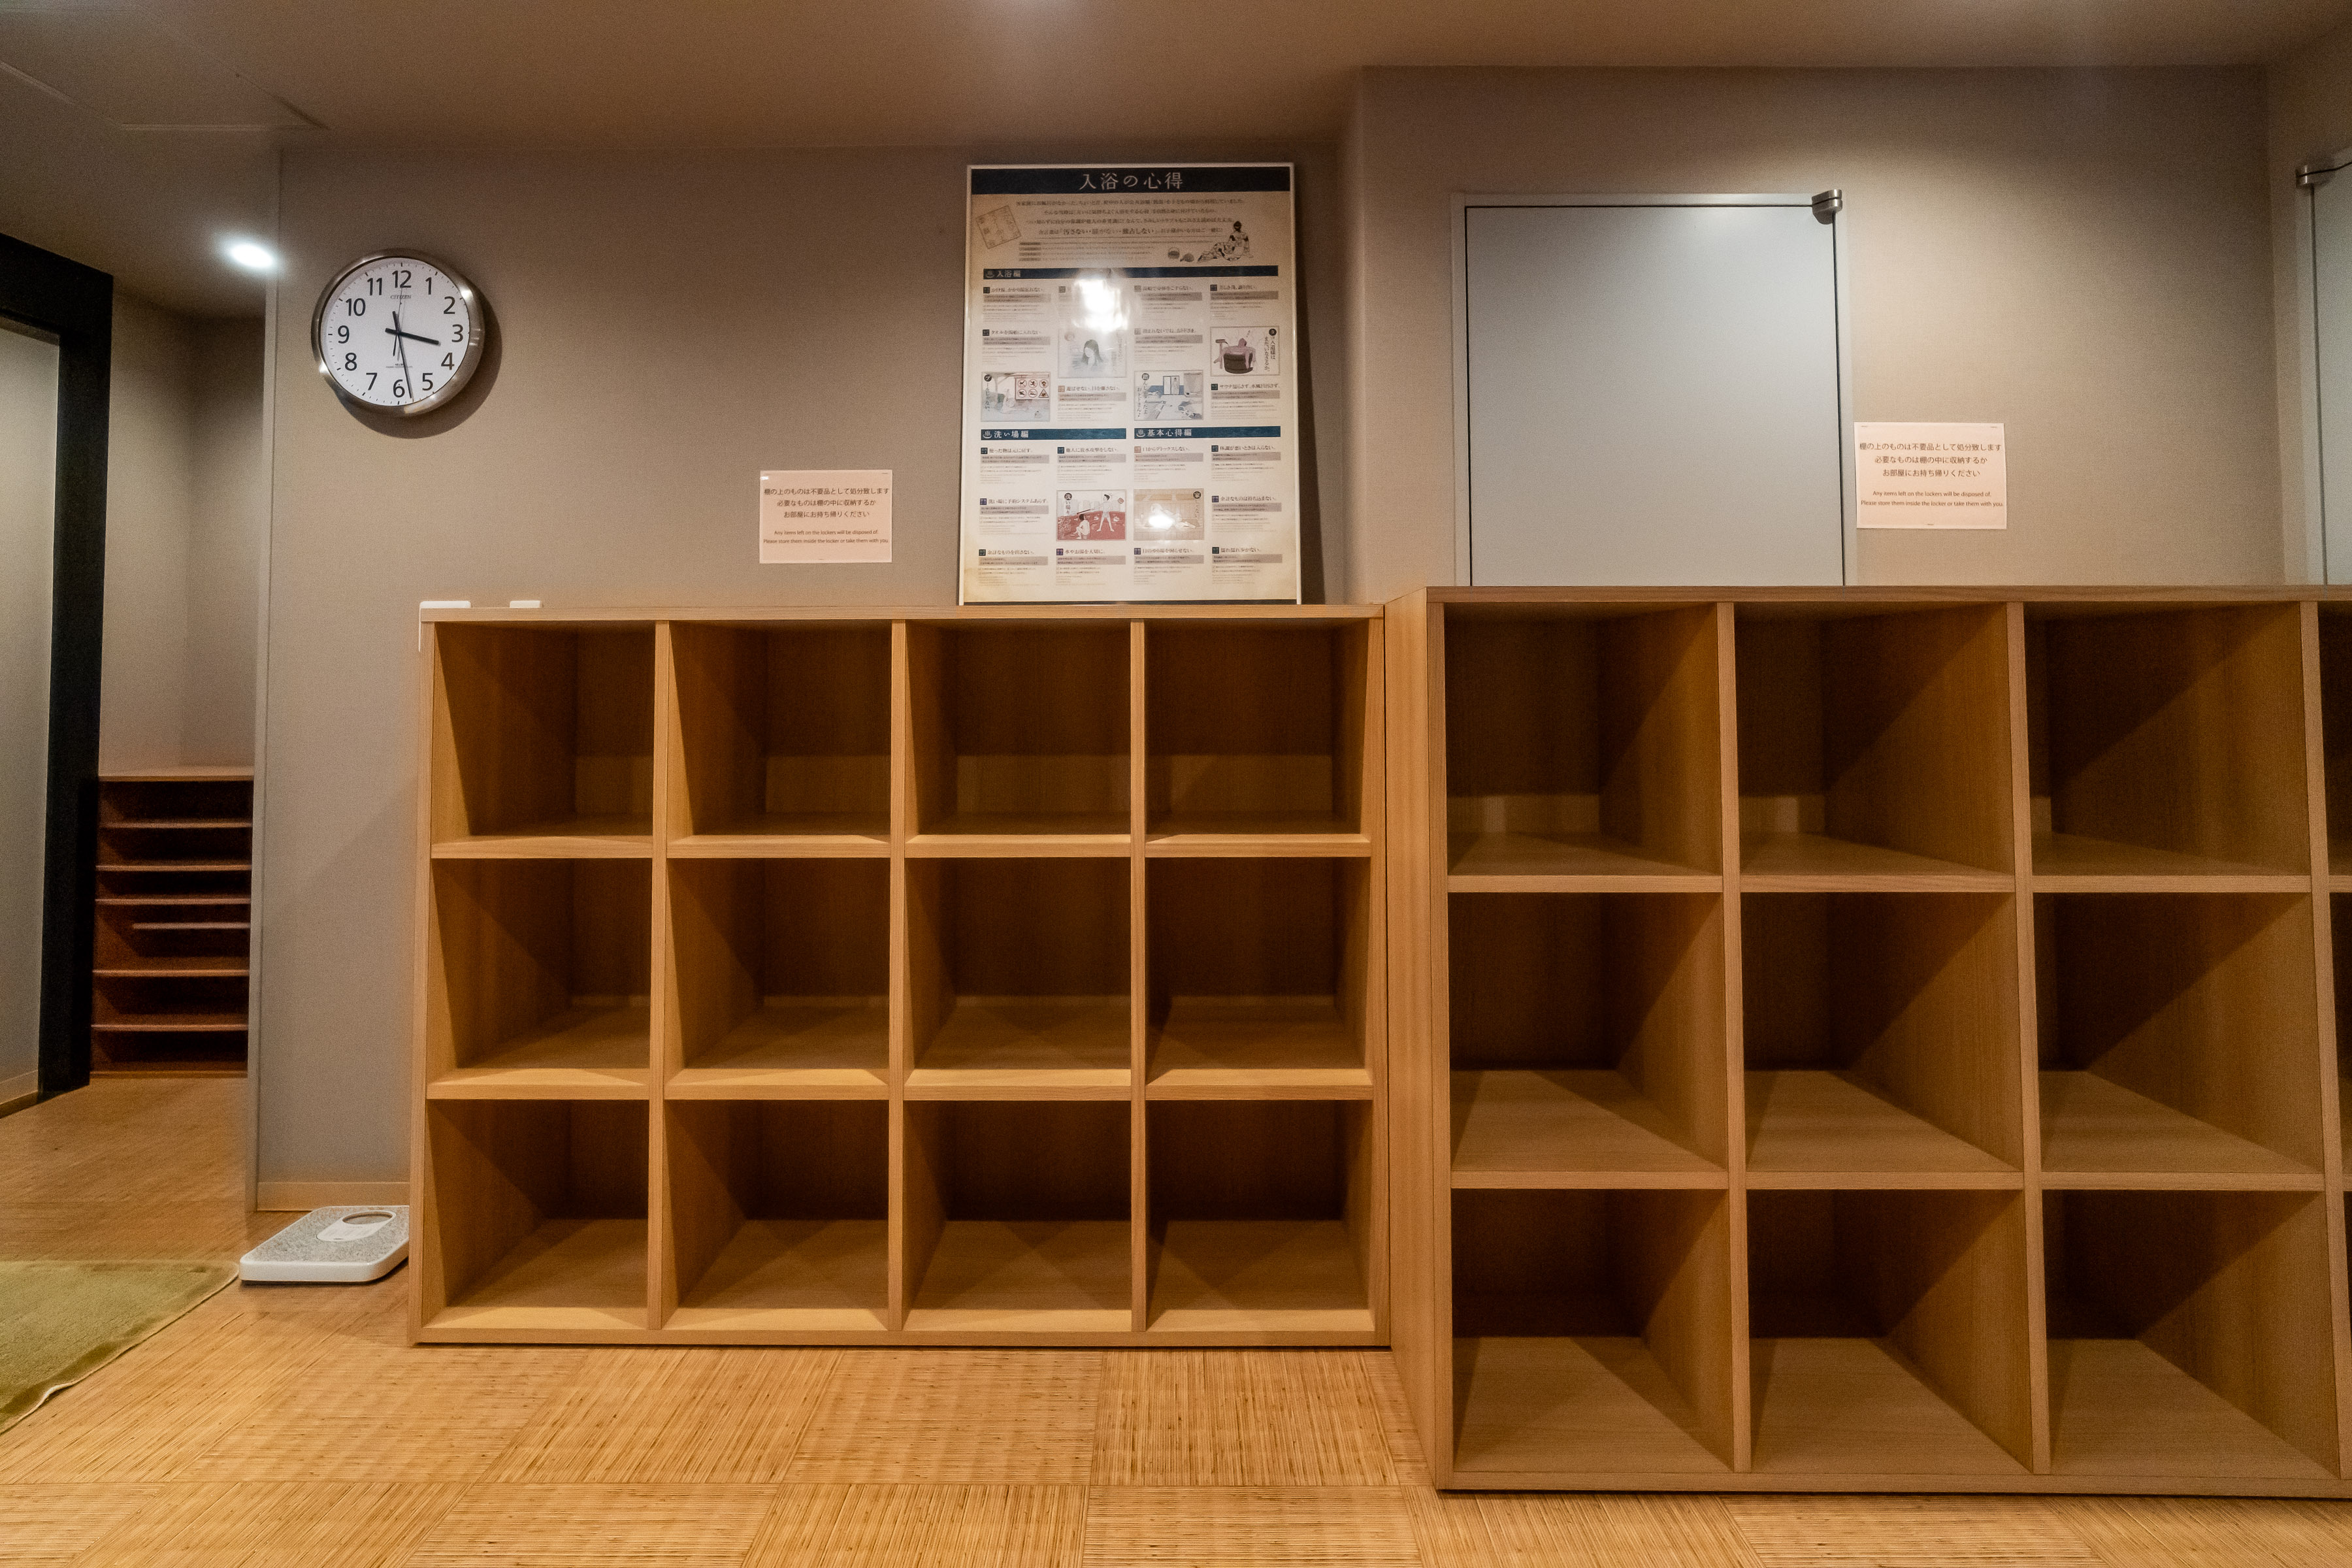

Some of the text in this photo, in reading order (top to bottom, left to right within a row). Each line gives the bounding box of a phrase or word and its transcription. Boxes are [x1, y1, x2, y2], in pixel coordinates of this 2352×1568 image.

[1079, 172, 1184, 190] 入浴の心得
[367, 278, 383, 295] 11
[392, 270, 412, 288] 12
[425, 277, 432, 295] 1
[346, 298, 366, 316] 10
[444, 297, 455, 314] 2
[338, 325, 350, 343] 9
[451, 325, 463, 342] 3
[345, 353, 357, 370] 8
[441, 353, 454, 370] 4
[366, 373, 377, 390] 7
[393, 380, 405, 397] 6
[422, 373, 433, 391] 5
